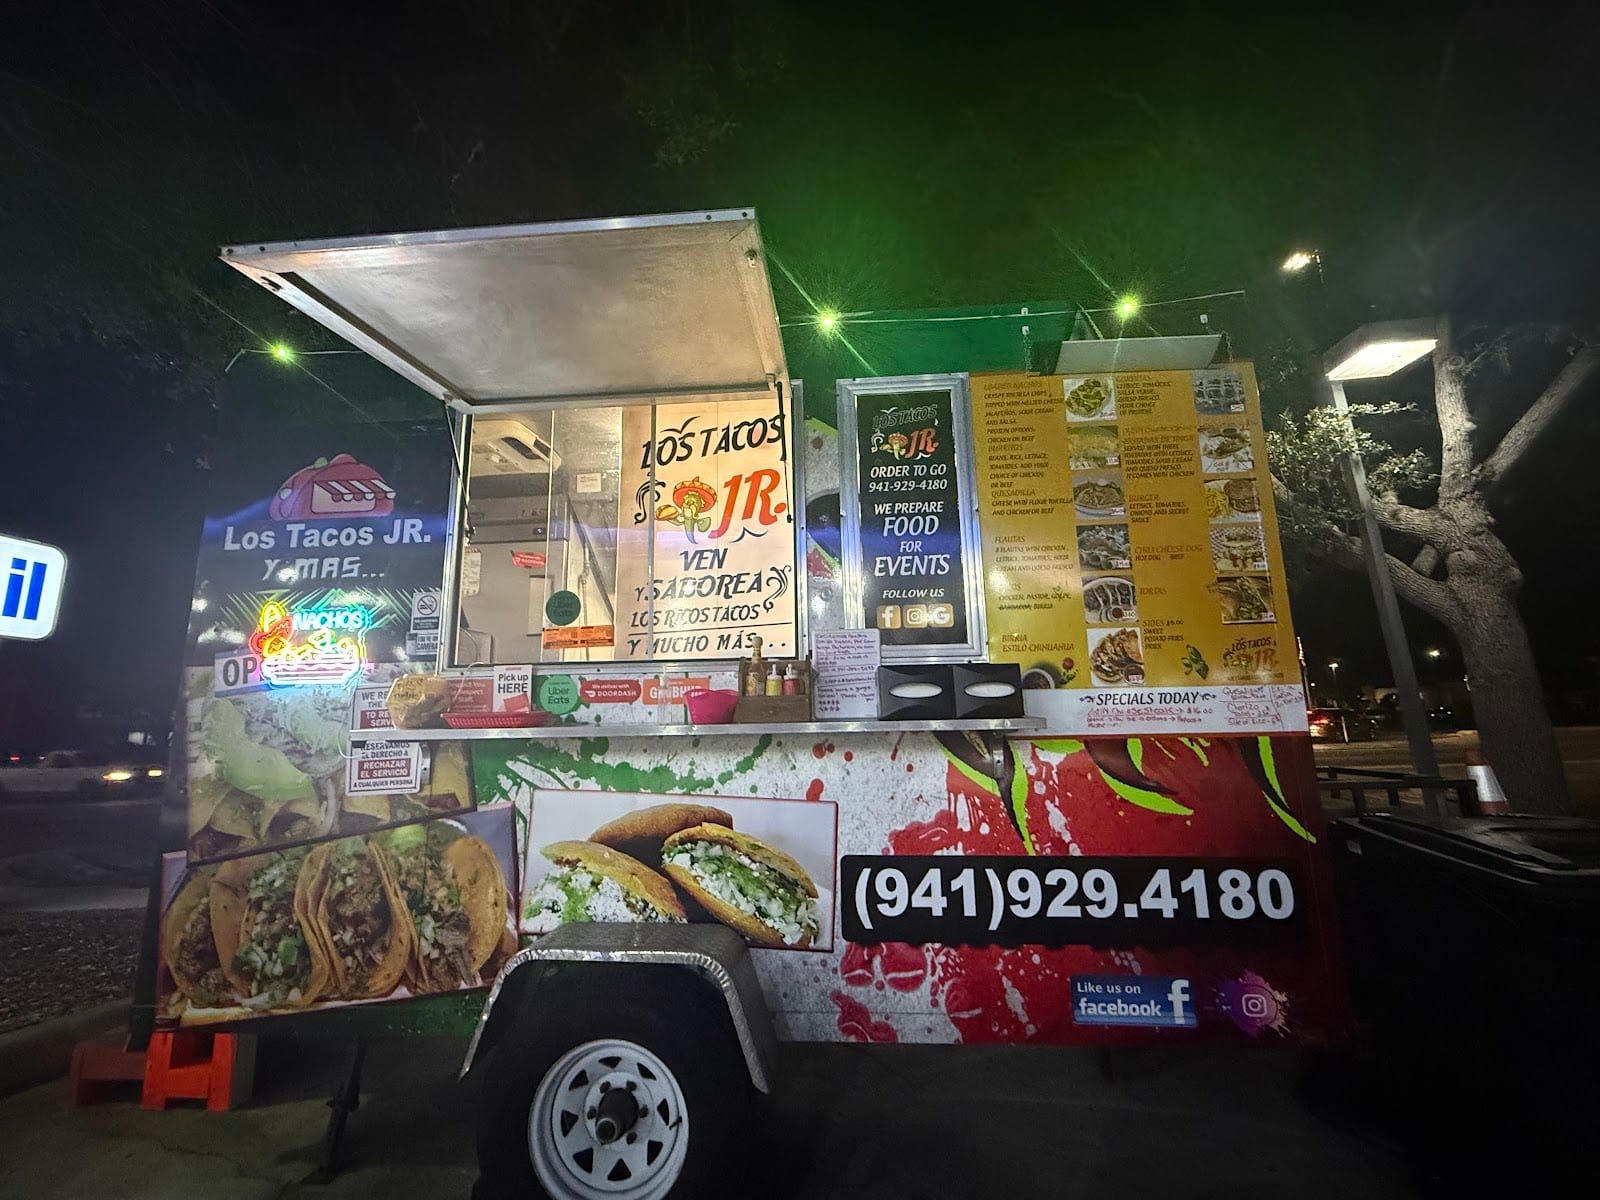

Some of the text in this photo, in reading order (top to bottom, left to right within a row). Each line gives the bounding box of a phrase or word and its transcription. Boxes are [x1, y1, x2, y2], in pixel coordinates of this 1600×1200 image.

[872, 404, 938, 430] LOS TACOS
[640, 413, 786, 469] LOS TACOS
[905, 428, 939, 458] JR.
[870, 463, 947, 478] ORDER TO GO
[868, 479, 948, 492] 941-929-4180
[992, 489, 1035, 498] QUESADILLA
[708, 468, 787, 539] JR.
[874, 501, 944, 515] WE PREPARE
[883, 515, 939, 537] FOOD
[224, 519, 431, 550] Los Tacos JR.
[995, 535, 1025, 543] FLAUTAS
[900, 541, 922, 553] FOR
[1156, 545, 1184, 553] CHEESE
[1185, 544, 1202, 552] DOG
[680, 548, 728, 572] VEN
[874, 554, 951, 577] EVENTS
[644, 571, 763, 601] SABOREA
[882, 588, 945, 599] FOLLOW US
[294, 610, 366, 631] NACHOS
[631, 604, 760, 628] LOS RICOS TACOS
[1143, 619, 1164, 627] SIDES
[1002, 634, 1027, 642] BIRRIA
[1248, 637, 1271, 649] TACOS
[627, 639, 641, 655] Y
[646, 635, 709, 654] MUCHO
[1003, 642, 1074, 652] ESTILO CHIHUAHUA
[498, 673, 515, 682] Pick
[498, 683, 528, 694] HERE
[548, 687, 569, 696] Uber
[362, 692, 377, 700] WE
[548, 696, 569, 704] Eats
[1096, 691, 1199, 706] SPECIALS TODAY
[371, 750, 402, 759] DERECHO
[403, 748, 408, 756] A
[363, 760, 406, 769] RECHAZAR
[361, 769, 408, 778] EL SERVICIO
[358, 780, 389, 788] CUALQUIER
[855, 867, 1295, 931] (941)929.4180
[1077, 981, 1141, 994] Like us on
[1078, 998, 1162, 1018] facebook
